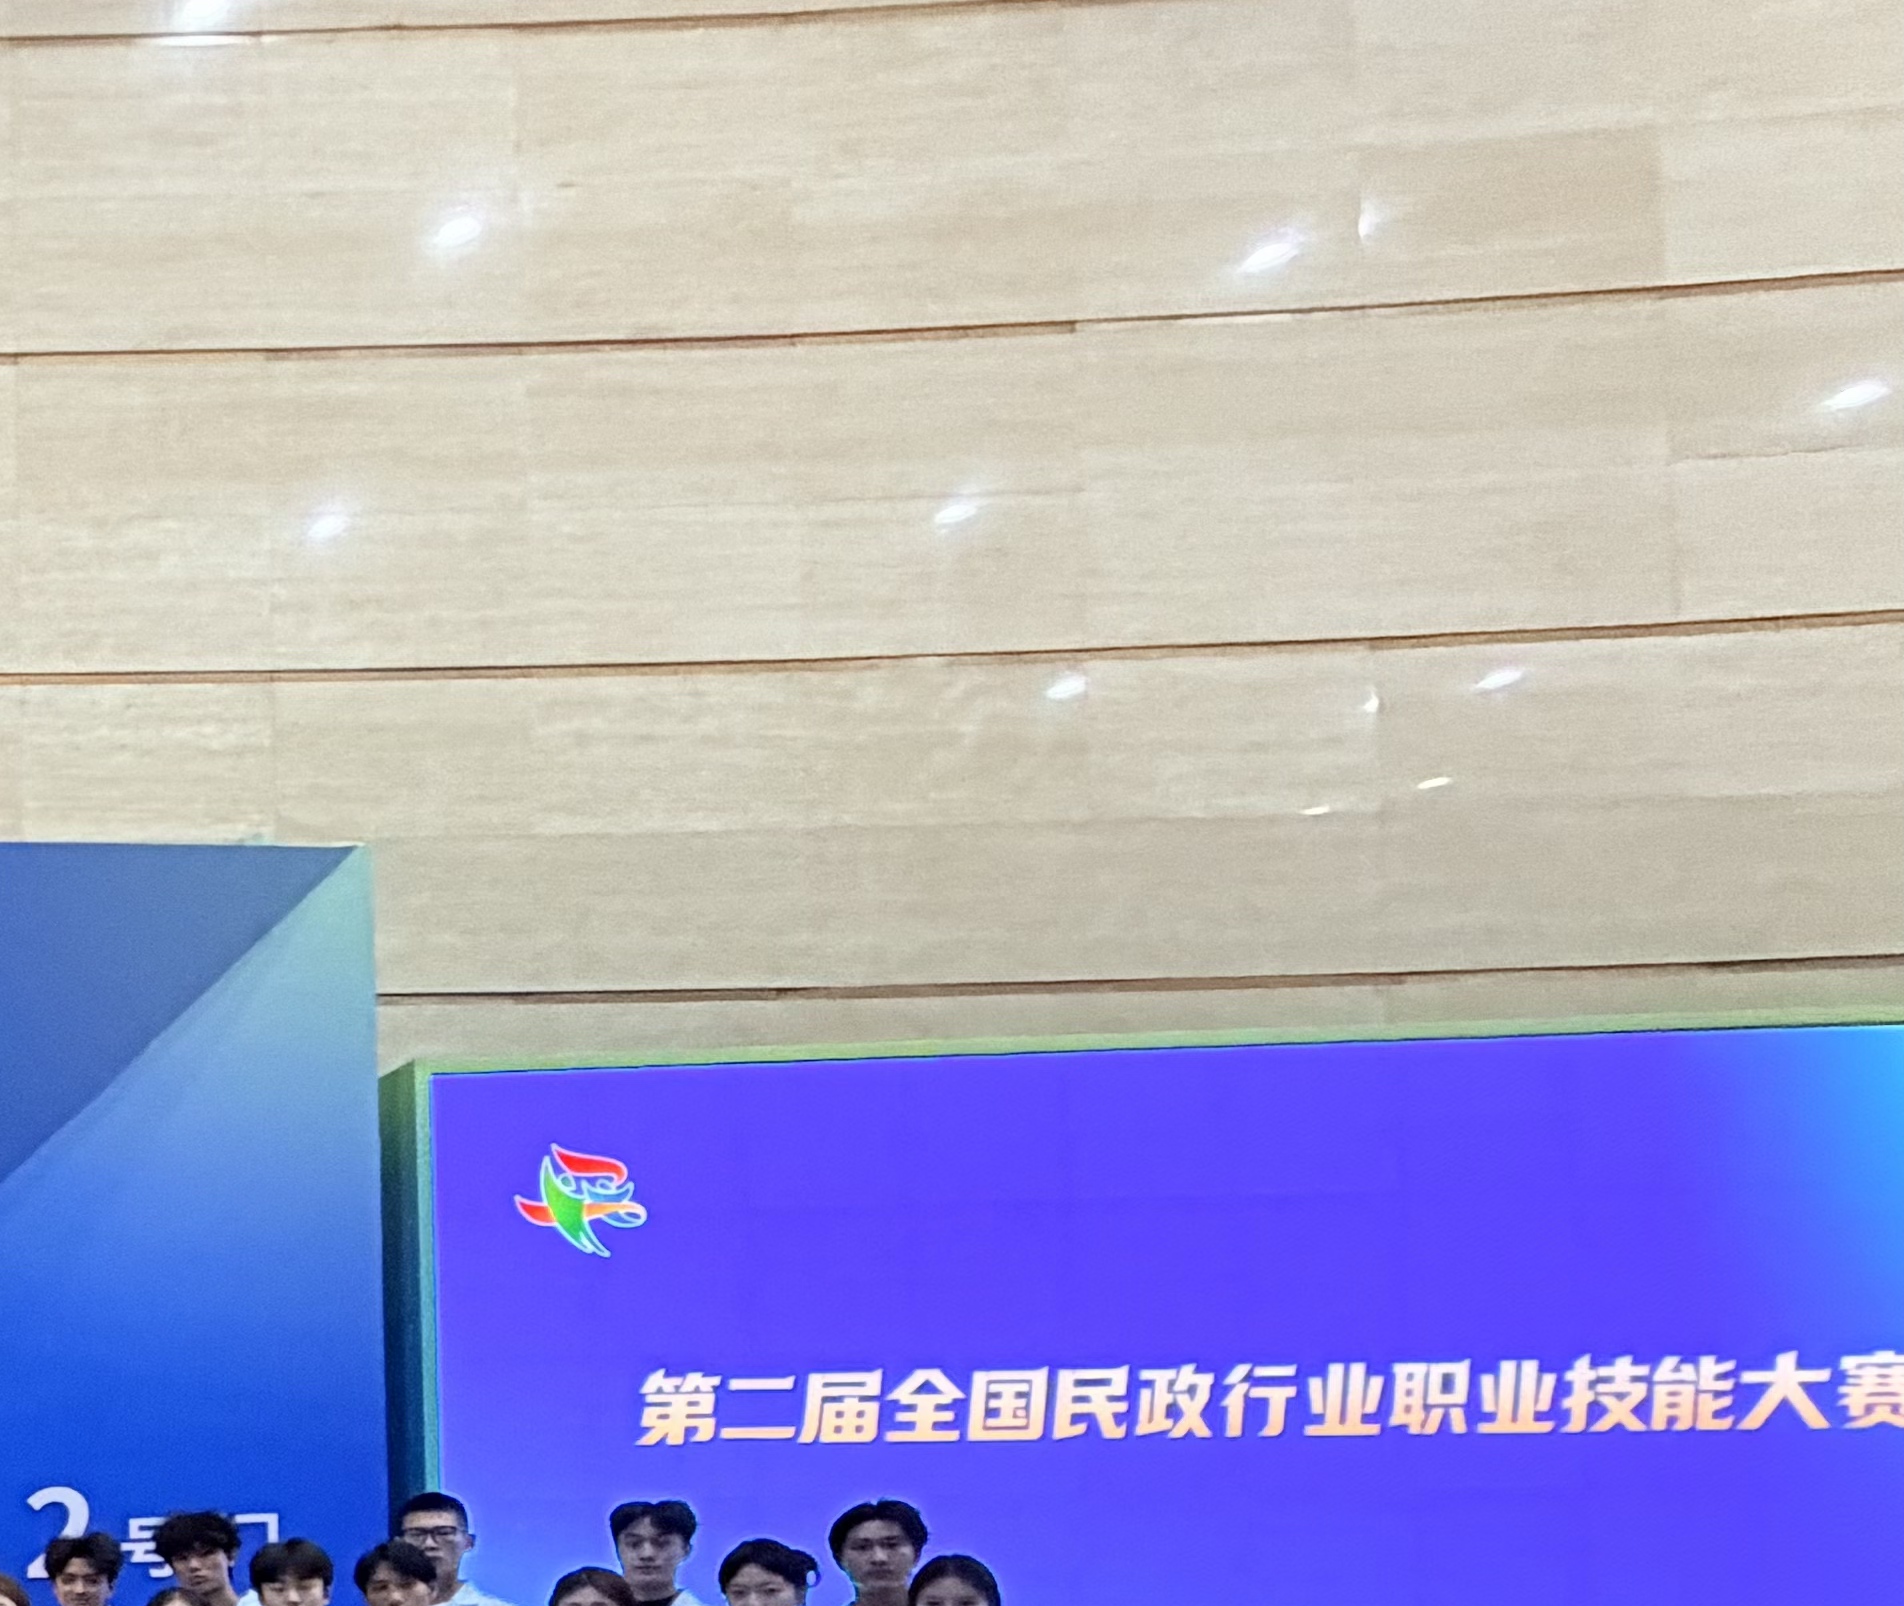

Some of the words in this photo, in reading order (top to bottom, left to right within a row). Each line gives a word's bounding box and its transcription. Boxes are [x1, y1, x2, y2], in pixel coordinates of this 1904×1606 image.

[636, 1349, 1904, 1447] 第二届全国民政行业职业技能大赛
